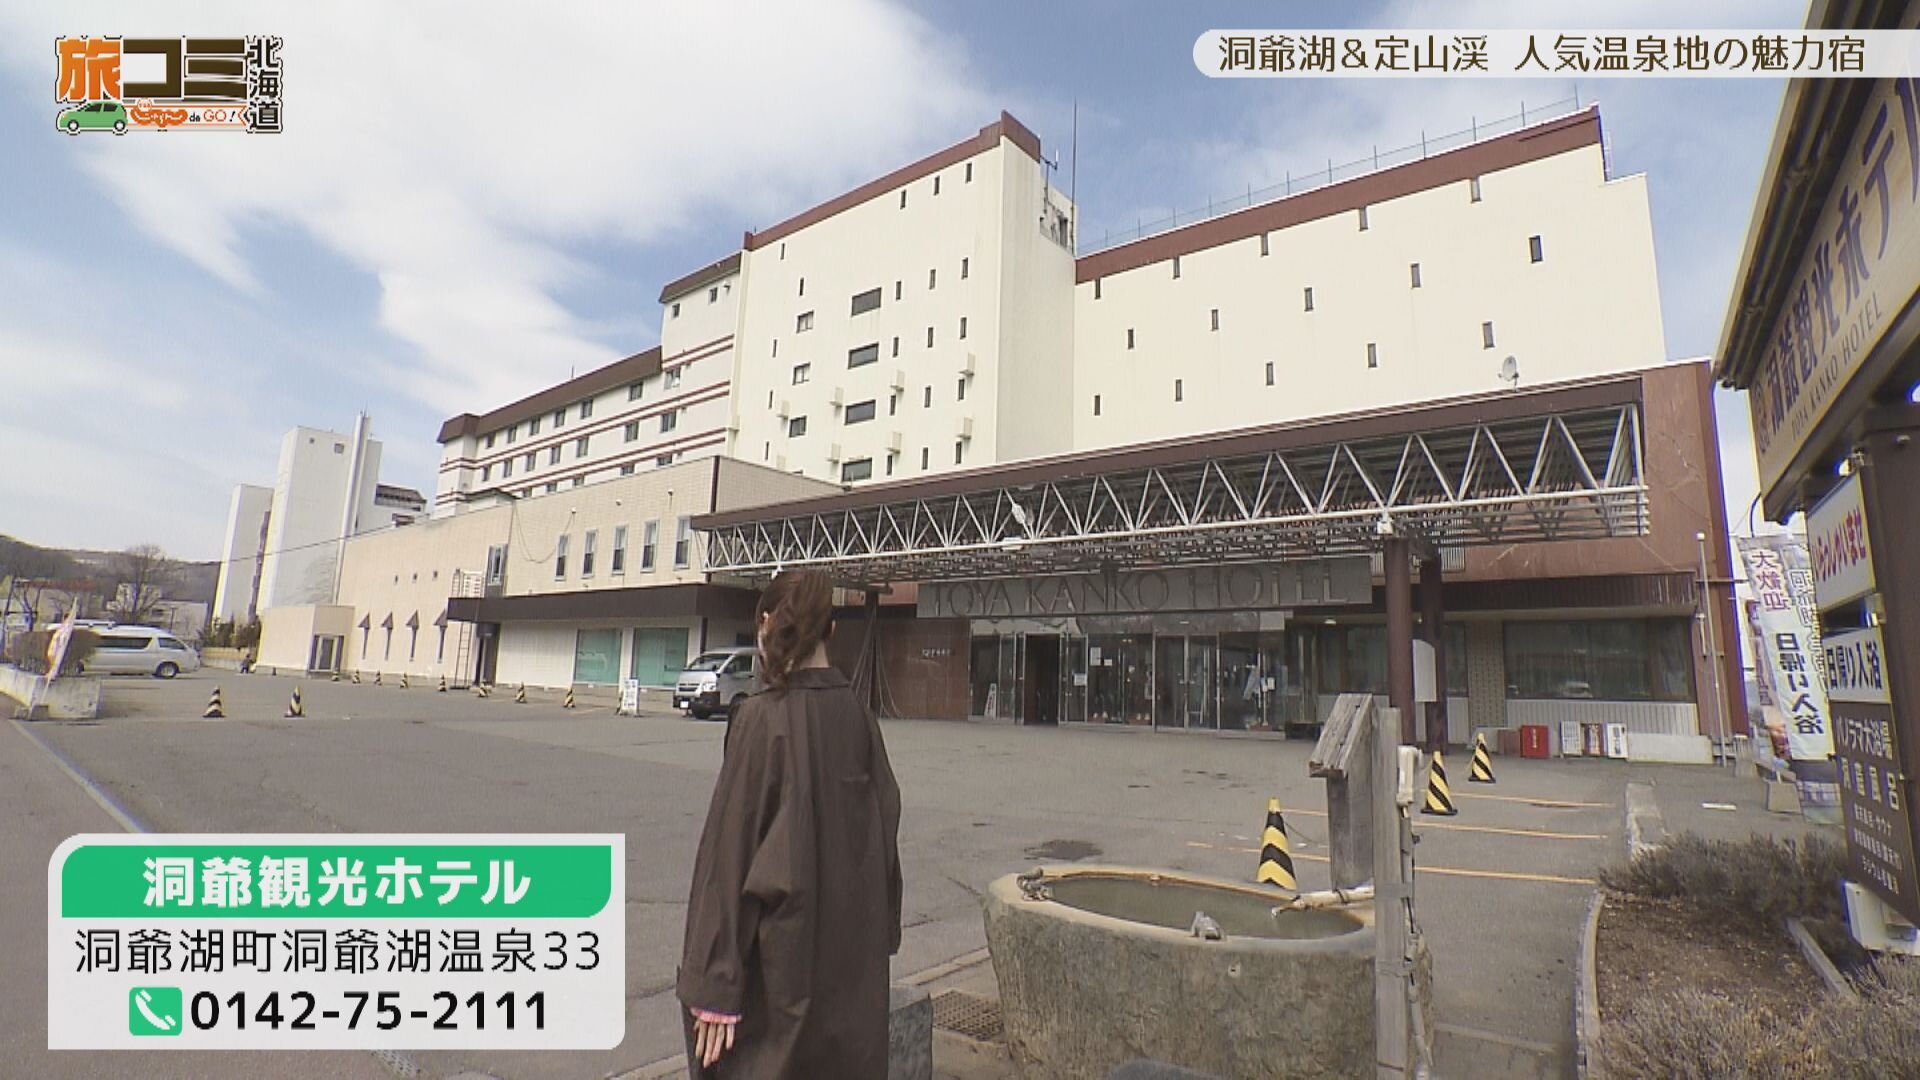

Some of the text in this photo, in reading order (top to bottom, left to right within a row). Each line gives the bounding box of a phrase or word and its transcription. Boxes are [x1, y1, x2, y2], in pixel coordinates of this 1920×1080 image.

[1841, 291, 1882, 365] HOTEL
[928, 580, 1014, 617] TOYA
[1024, 567, 1170, 615] KANKO
[1826, 640, 1882, 690] 日帰り入浴
